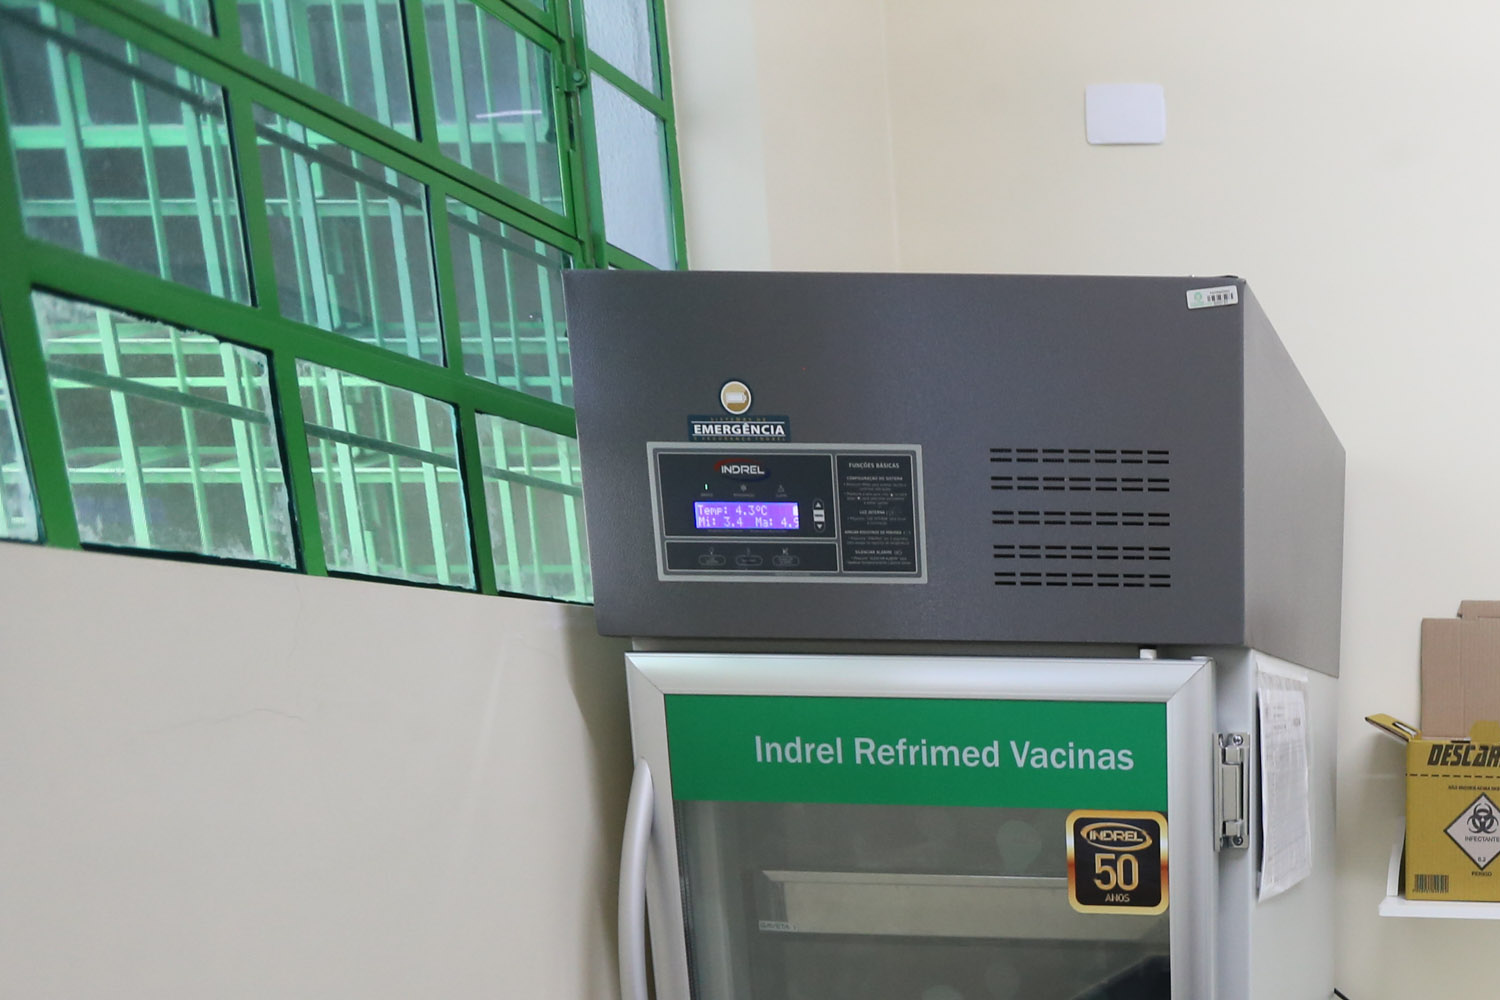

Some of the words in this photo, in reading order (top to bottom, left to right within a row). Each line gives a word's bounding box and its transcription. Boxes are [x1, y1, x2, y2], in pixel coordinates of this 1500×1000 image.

[693, 422, 785, 435] EMERGÊNCIA
[720, 465, 765, 475] INDREL
[848, 462, 875, 470] FUNÇÕES
[698, 505, 728, 516] Temp:
[698, 517, 716, 527] Mi:
[723, 517, 743, 527] 3.4
[755, 517, 773, 527] Ma:
[754, 735, 843, 765] Indrel
[854, 737, 1000, 767] Refrimed
[1009, 740, 1135, 771] Vacinas
[1089, 830, 1144, 842] INDREL
[1093, 853, 1139, 891] 50
[1104, 893, 1131, 903] ANOS
